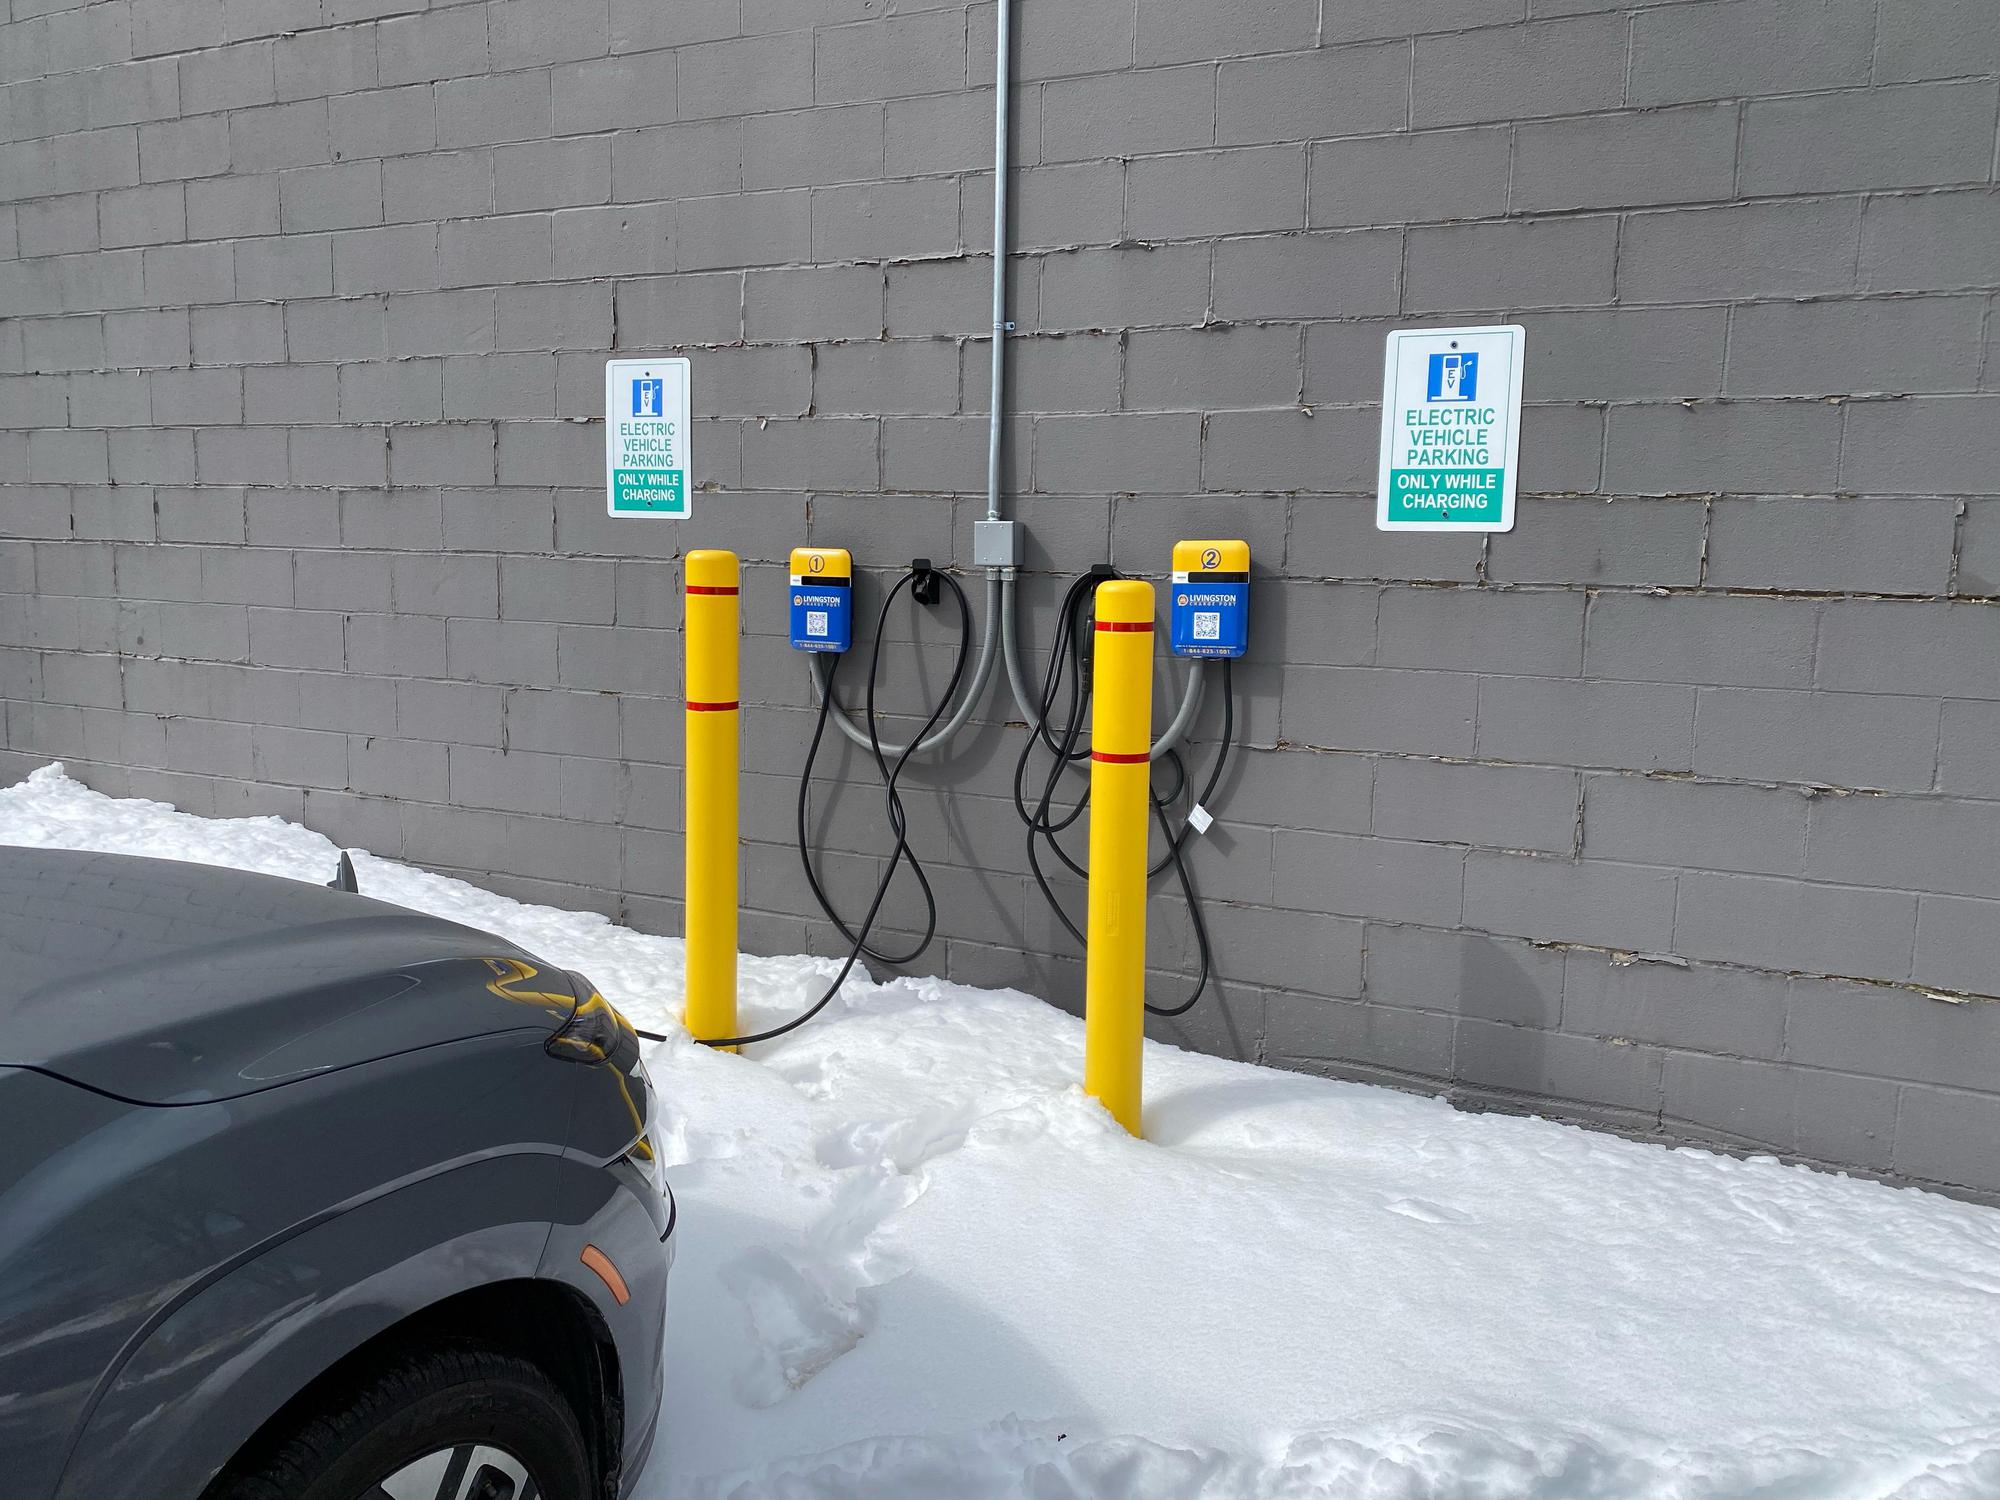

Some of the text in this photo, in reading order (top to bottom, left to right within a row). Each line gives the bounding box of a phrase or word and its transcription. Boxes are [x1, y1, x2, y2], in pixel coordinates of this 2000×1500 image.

[1447, 369, 1456, 388] EV
[644, 392, 650, 407] EV
[1406, 408, 1496, 426] ELECTRIC
[620, 422, 676, 436] ELECTRIC
[1410, 428, 1488, 446] VEHICLE
[623, 438, 672, 452] VEHICLE
[623, 454, 674, 467] PARKING
[1407, 448, 1489, 466] PARKING
[618, 473, 679, 486] ONLY WHILE
[1397, 473, 1496, 489] ONLY WHILE
[622, 488, 676, 501] CHARGING
[1402, 493, 1488, 509] CHARGING
[814, 557, 819, 570] 1
[1206, 551, 1217, 566] 2
[803, 595, 840, 603] LIVINGSTON
[1189, 594, 1236, 602] LIVINGSTON
